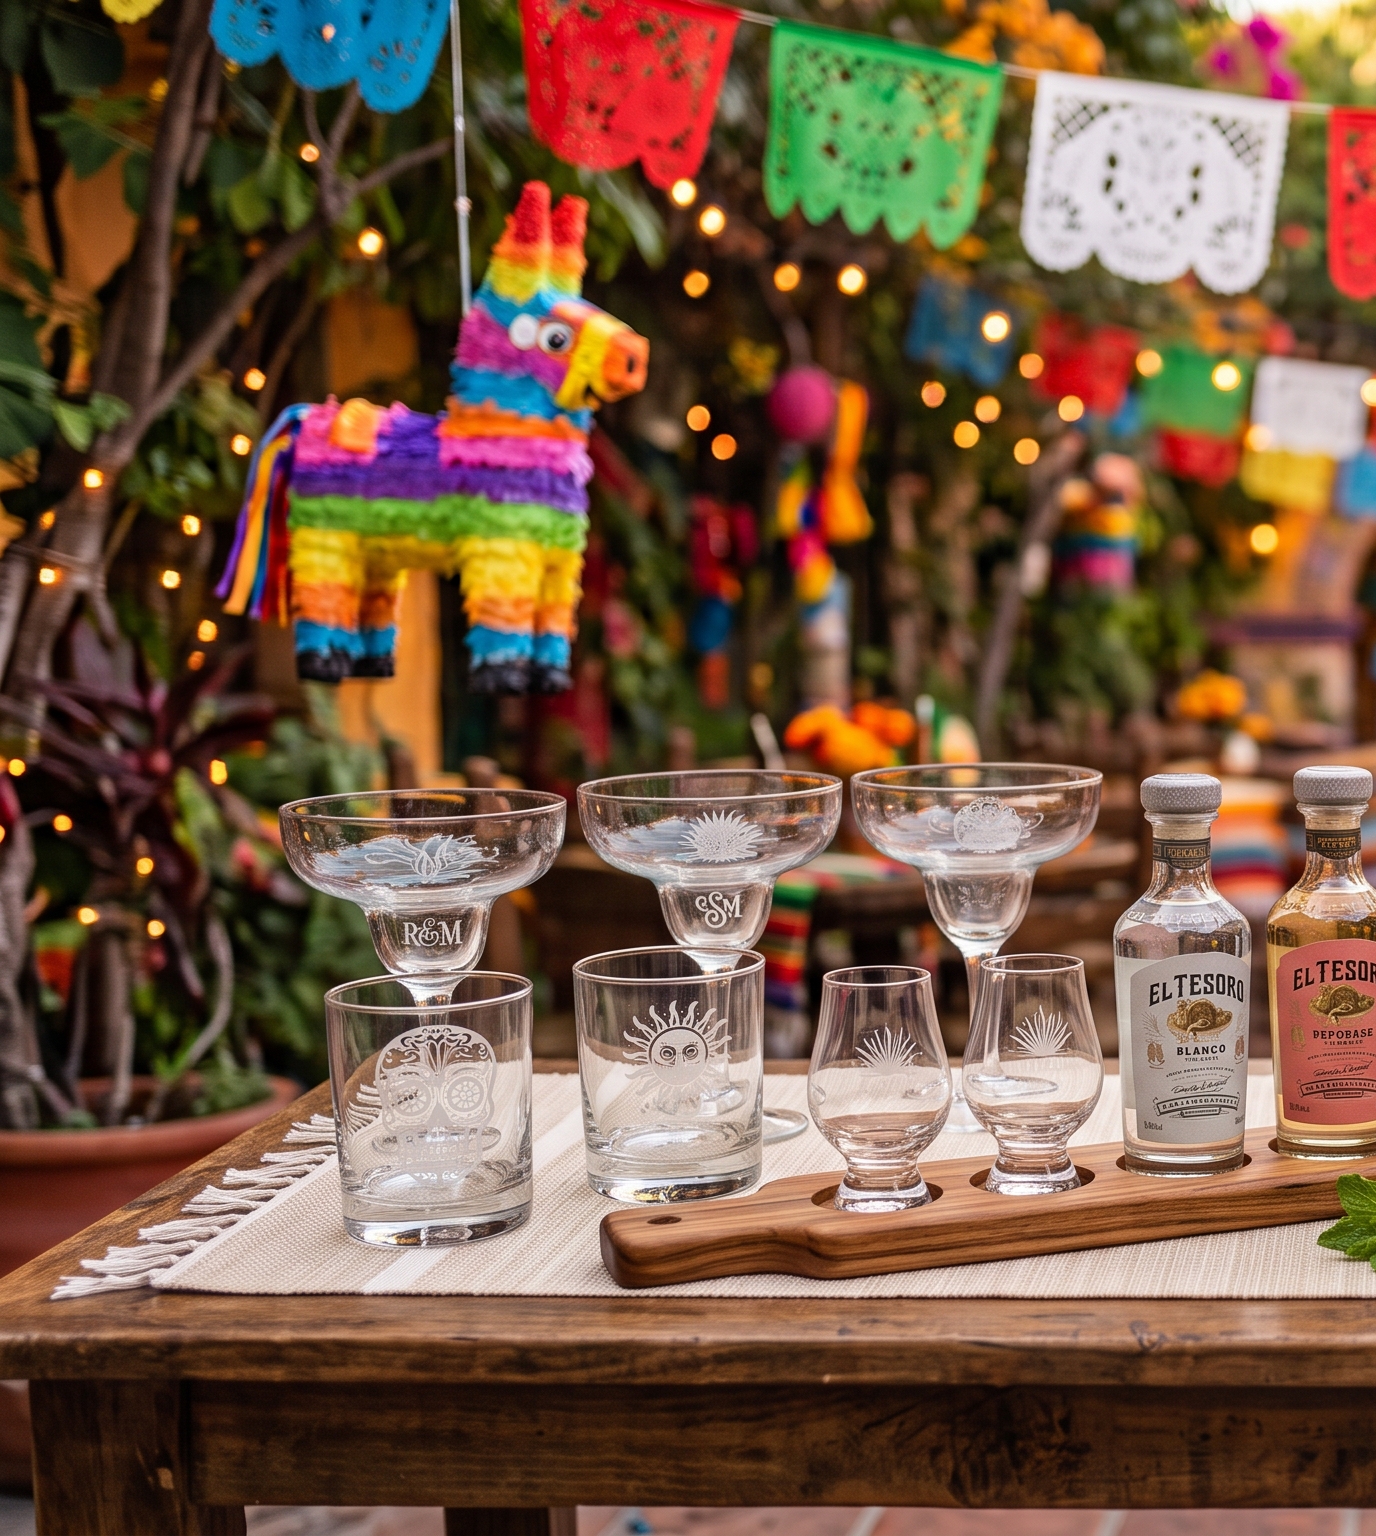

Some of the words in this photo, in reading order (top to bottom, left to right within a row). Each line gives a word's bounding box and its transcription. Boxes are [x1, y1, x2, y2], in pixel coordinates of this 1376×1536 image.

[401, 917, 463, 947] R&M
[1148, 981, 1173, 1007] EL
[1173, 973, 1245, 1003] TESORO
[1293, 967, 1315, 991] EL
[1176, 1044, 1226, 1056] BLANCO
